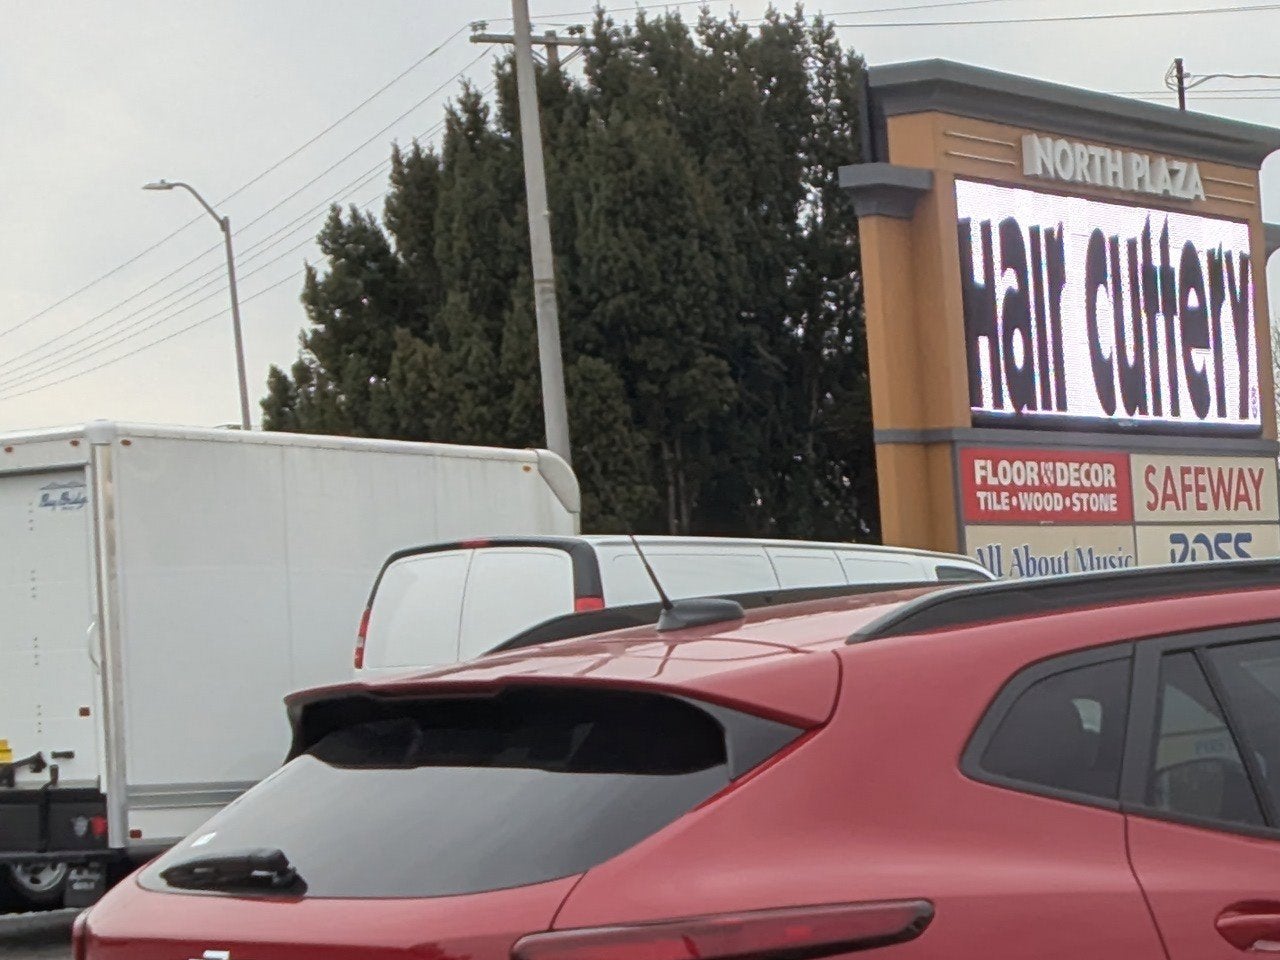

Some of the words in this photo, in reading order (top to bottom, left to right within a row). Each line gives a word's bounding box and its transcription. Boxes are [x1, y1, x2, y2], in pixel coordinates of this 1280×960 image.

[1022, 133, 1124, 189] NORTH
[1124, 152, 1207, 202] PLAZA
[958, 216, 1066, 414] Hair
[974, 459, 1040, 486] FLOOR
[1056, 462, 1117, 488] DECOR
[1144, 464, 1264, 512] SAFEWAY
[976, 491, 1011, 511] TILE
[1018, 491, 1064, 512] WOOD
[1072, 492, 1118, 512] STONE
[1009, 544, 1070, 578] About
[1075, 546, 1133, 572] Music
